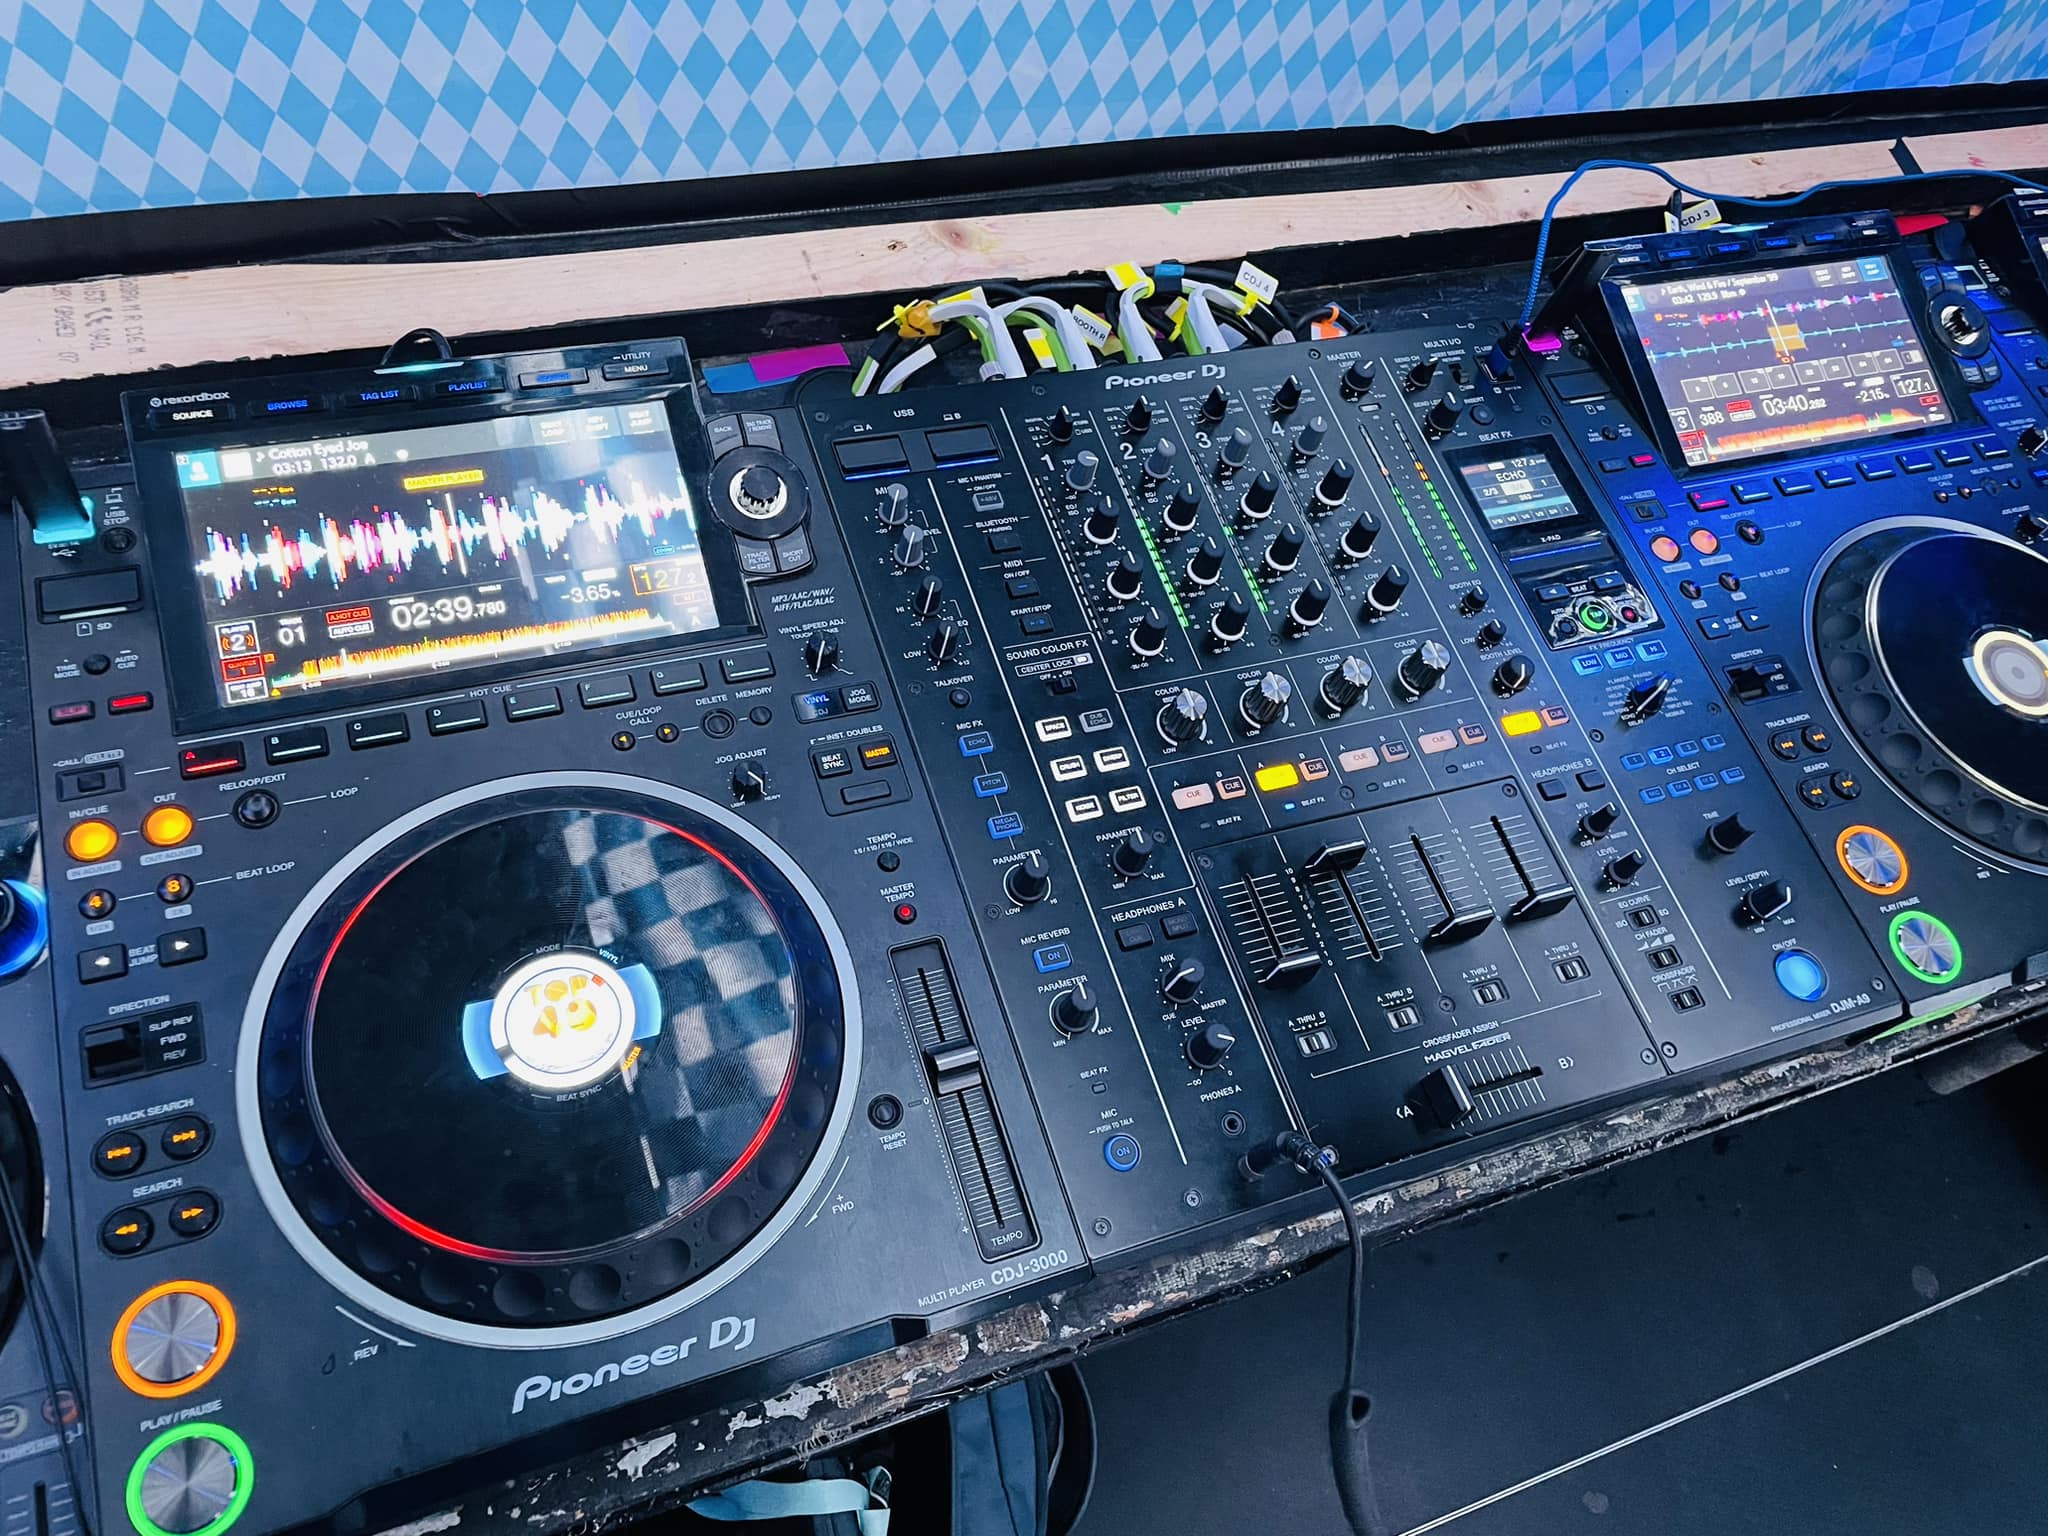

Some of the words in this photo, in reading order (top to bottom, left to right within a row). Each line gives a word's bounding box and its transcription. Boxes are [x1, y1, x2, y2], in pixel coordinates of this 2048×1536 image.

[1681, 213, 1702, 226] CDJ
[1704, 210, 1711, 218] 3
[1243, 271, 1262, 287] CDJ
[1263, 284, 1269, 292] 4
[621, 352, 651, 361] UTILITY
[1327, 351, 1361, 361] MASTER
[624, 364, 649, 374] MENU
[1105, 370, 1196, 390] Pioneer
[1202, 364, 1226, 379] DJ
[448, 380, 488, 391] PLAYLIST
[162, 391, 230, 405] rekordbox
[360, 392, 377, 401] TAG
[379, 390, 399, 400] LIST
[268, 400, 308, 411] BROWSE
[172, 409, 213, 421] SOURCE
[893, 408, 915, 418] USB
[1699, 411, 1724, 426] 388
[1271, 421, 1285, 437] 4
[1195, 432, 1212, 449] 3
[1478, 433, 1499, 442] BEAT
[1500, 430, 1513, 439] FX
[268, 446, 312, 461] Cotton
[313, 442, 344, 459] Eyed
[345, 440, 369, 453] Joe
[1119, 443, 1137, 460] 2
[272, 460, 312, 475] 03:13
[364, 453, 375, 465] A
[1040, 453, 1055, 472] 1
[1496, 470, 1527, 482] ECHO
[105, 510, 126, 518] USB
[104, 516, 129, 526] STOP
[975, 516, 1019, 529] BLUETOOTH
[1003, 560, 1023, 569] MIDI
[1004, 570, 1030, 579] ON/OFF
[1010, 604, 1052, 616] START/STOP
[97, 622, 111, 631] SD
[778, 626, 801, 635] VINYL
[802, 621, 828, 631] SPEED
[279, 627, 305, 646] 01
[903, 651, 921, 659] LOW
[1006, 648, 1040, 662] SOUND
[1040, 642, 1075, 655] COLOR
[1076, 639, 1089, 648] FX
[1730, 648, 1763, 661] DIRECTION
[115, 654, 138, 663] AUTO
[117, 660, 136, 670] CUE
[55, 664, 76, 673] TIME
[1020, 663, 1050, 674] CENTER
[1052, 659, 1073, 668] LOCK
[54, 669, 80, 679] MODE
[1237, 670, 1262, 680] COLOR
[934, 675, 974, 688] TALKOVER
[470, 687, 489, 697] HOT
[492, 684, 512, 694] CUE
[695, 694, 728, 706] DELETE
[735, 686, 772, 699] MEMORY
[1155, 686, 1180, 697] COLOR
[804, 694, 829, 704] VINYL
[616, 705, 662, 721] CUE/LOOP
[630, 717, 653, 726] CALL
[956, 721, 971, 731] MIC
[972, 719, 984, 728] FX
[715, 754, 733, 764] JOG
[734, 748, 768, 761] ADJUST
[822, 754, 841, 763] BEAT
[865, 747, 890, 758] MASTER
[823, 760, 845, 770] SYNC
[1308, 762, 1324, 772] CUE
[1531, 760, 1583, 779] HEADPHONES
[1584, 758, 1593, 768] B
[1666, 768, 1678, 776] CH
[1679, 762, 1700, 774] SELECT
[219, 772, 287, 792] RELOOP/EXIT
[1225, 781, 1241, 791] CUE
[154, 793, 176, 803] OUT
[330, 787, 359, 800] LOOP
[69, 805, 109, 819] IN/CUE
[867, 832, 896, 845] TEMPO
[236, 867, 262, 880] BEAT
[264, 861, 296, 876] LOOP
[1725, 869, 1770, 887] LEVEL/DEPTH
[167, 880, 181, 893] 8
[880, 882, 914, 896] MASTER
[885, 890, 914, 903] TEMPO
[1005, 907, 1021, 916] LOW
[1111, 901, 1175, 923] HEADPHONES
[1178, 897, 1187, 907] A
[1020, 935, 1037, 945] MIC
[1037, 927, 1070, 942] REVERB
[128, 945, 156, 957] BEAT
[536, 943, 561, 953] MODE
[129, 954, 158, 967] JUMP
[1047, 951, 1061, 961] ON
[1651, 966, 1696, 983] CROSSFADER
[524, 974, 588, 1006] TOP
[108, 994, 170, 1015] DIRECTION
[1201, 998, 1227, 1011] MASTER
[1830, 993, 1871, 1014] DJM-A9
[149, 1020, 171, 1032] SLIP
[173, 1015, 193, 1027] REV
[1181, 1016, 1205, 1028] LEVEL
[1297, 1014, 1316, 1025] THRU
[160, 1033, 187, 1046] FWD
[1422, 1028, 1471, 1048] CROSSFADER
[1472, 1021, 1499, 1036] ASSIGN
[1424, 1045, 1469, 1064] MAGVEL
[1471, 1032, 1511, 1051] FADER
[163, 1048, 187, 1062] REV
[1080, 1068, 1098, 1079] BEAT
[1099, 1066, 1109, 1074] FX
[557, 1092, 578, 1103] BEAT
[579, 1085, 602, 1099] SYNC
[1200, 1086, 1234, 1103] PHONES
[1235, 1084, 1243, 1093] A
[106, 1108, 146, 1126] TRACK
[147, 1098, 195, 1118] SEARCH
[1101, 1108, 1118, 1120] MIC
[1112, 1122, 1119, 1130] TO
[1120, 1117, 1134, 1128] TALK
[879, 1131, 906, 1144] TEMPO
[883, 1138, 907, 1151] RESET
[133, 1177, 182, 1198] SEARCH
[832, 1201, 854, 1214] FWD
[991, 1231, 1023, 1247] TEMPO
[918, 1291, 947, 1307] MULTI
[949, 1279, 985, 1297] PLAYER
[991, 1250, 1068, 1285] CDJ-3000
[354, 1345, 379, 1361] REV
[512, 1336, 697, 1414] Pioneer
[709, 1316, 756, 1351] DJ
